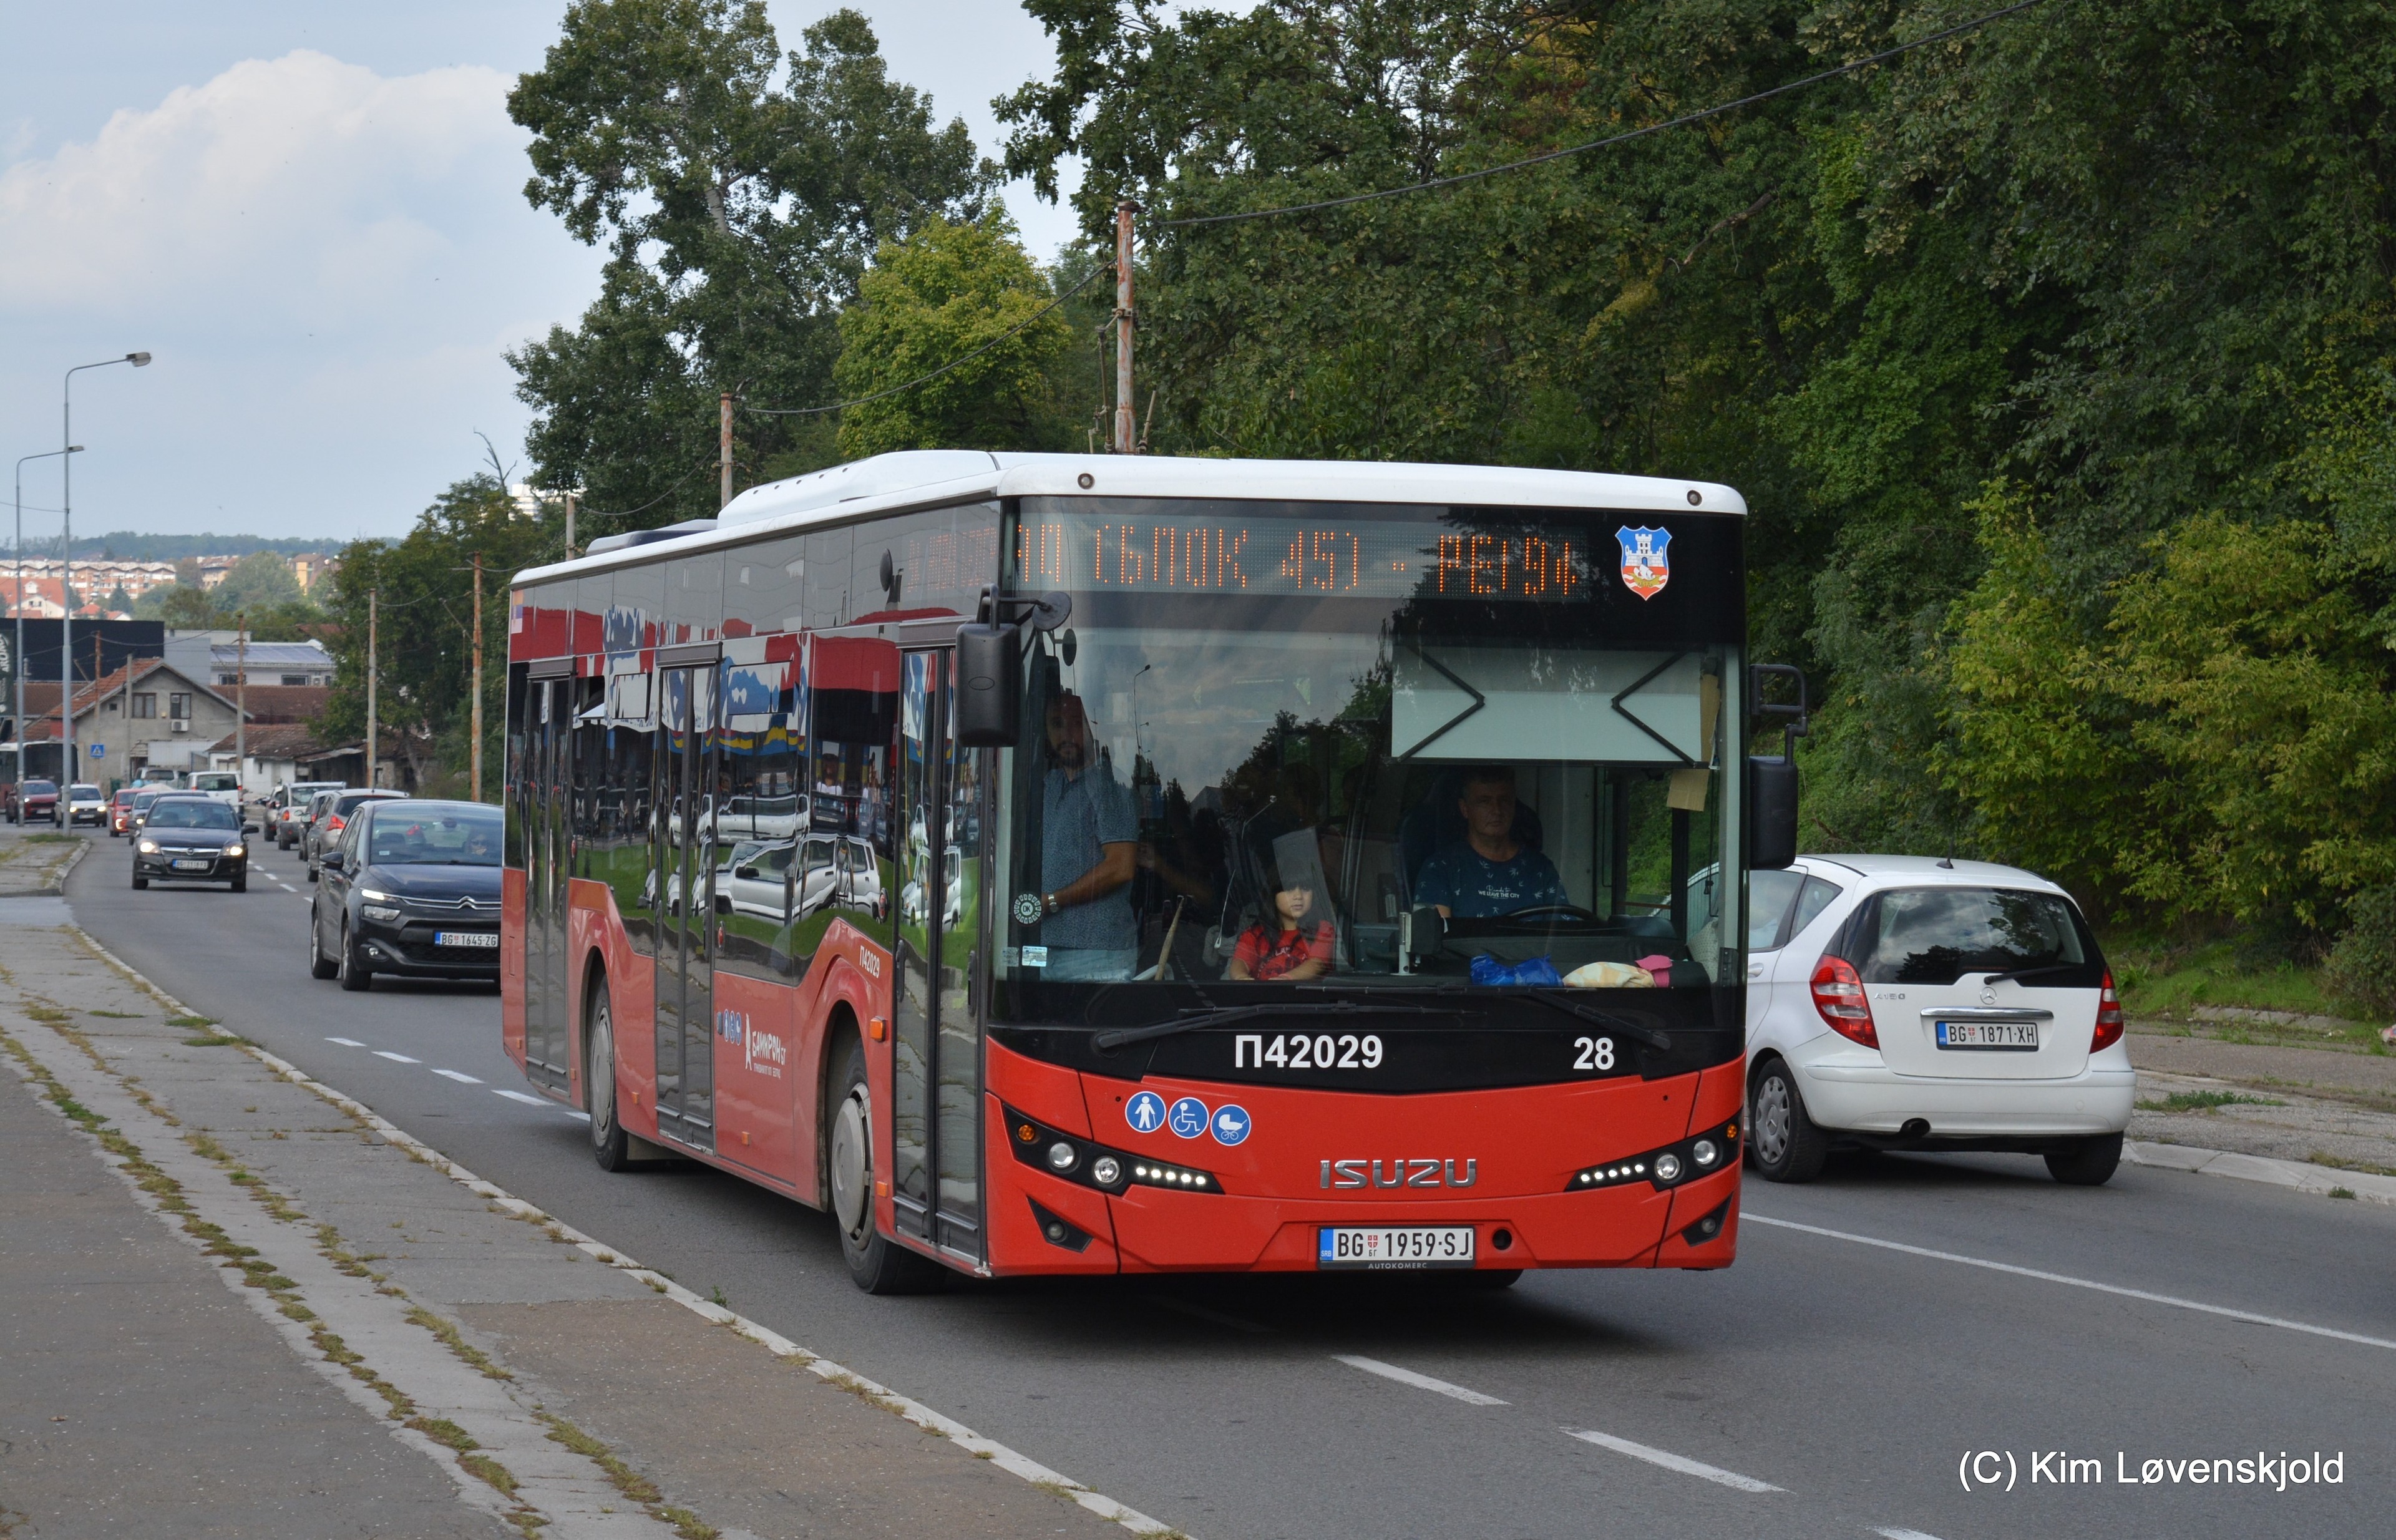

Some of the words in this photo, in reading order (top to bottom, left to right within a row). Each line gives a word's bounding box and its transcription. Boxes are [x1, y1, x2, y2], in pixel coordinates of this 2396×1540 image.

[442, 935, 453, 944] BG
[859, 945, 880, 978] П42029
[1949, 1026, 1966, 1042] BG
[1235, 1035, 1383, 1068] П42029
[1573, 1036, 1615, 1070] 28
[1319, 1159, 1477, 1189] ISUZU
[1338, 1233, 1363, 1257] BG
